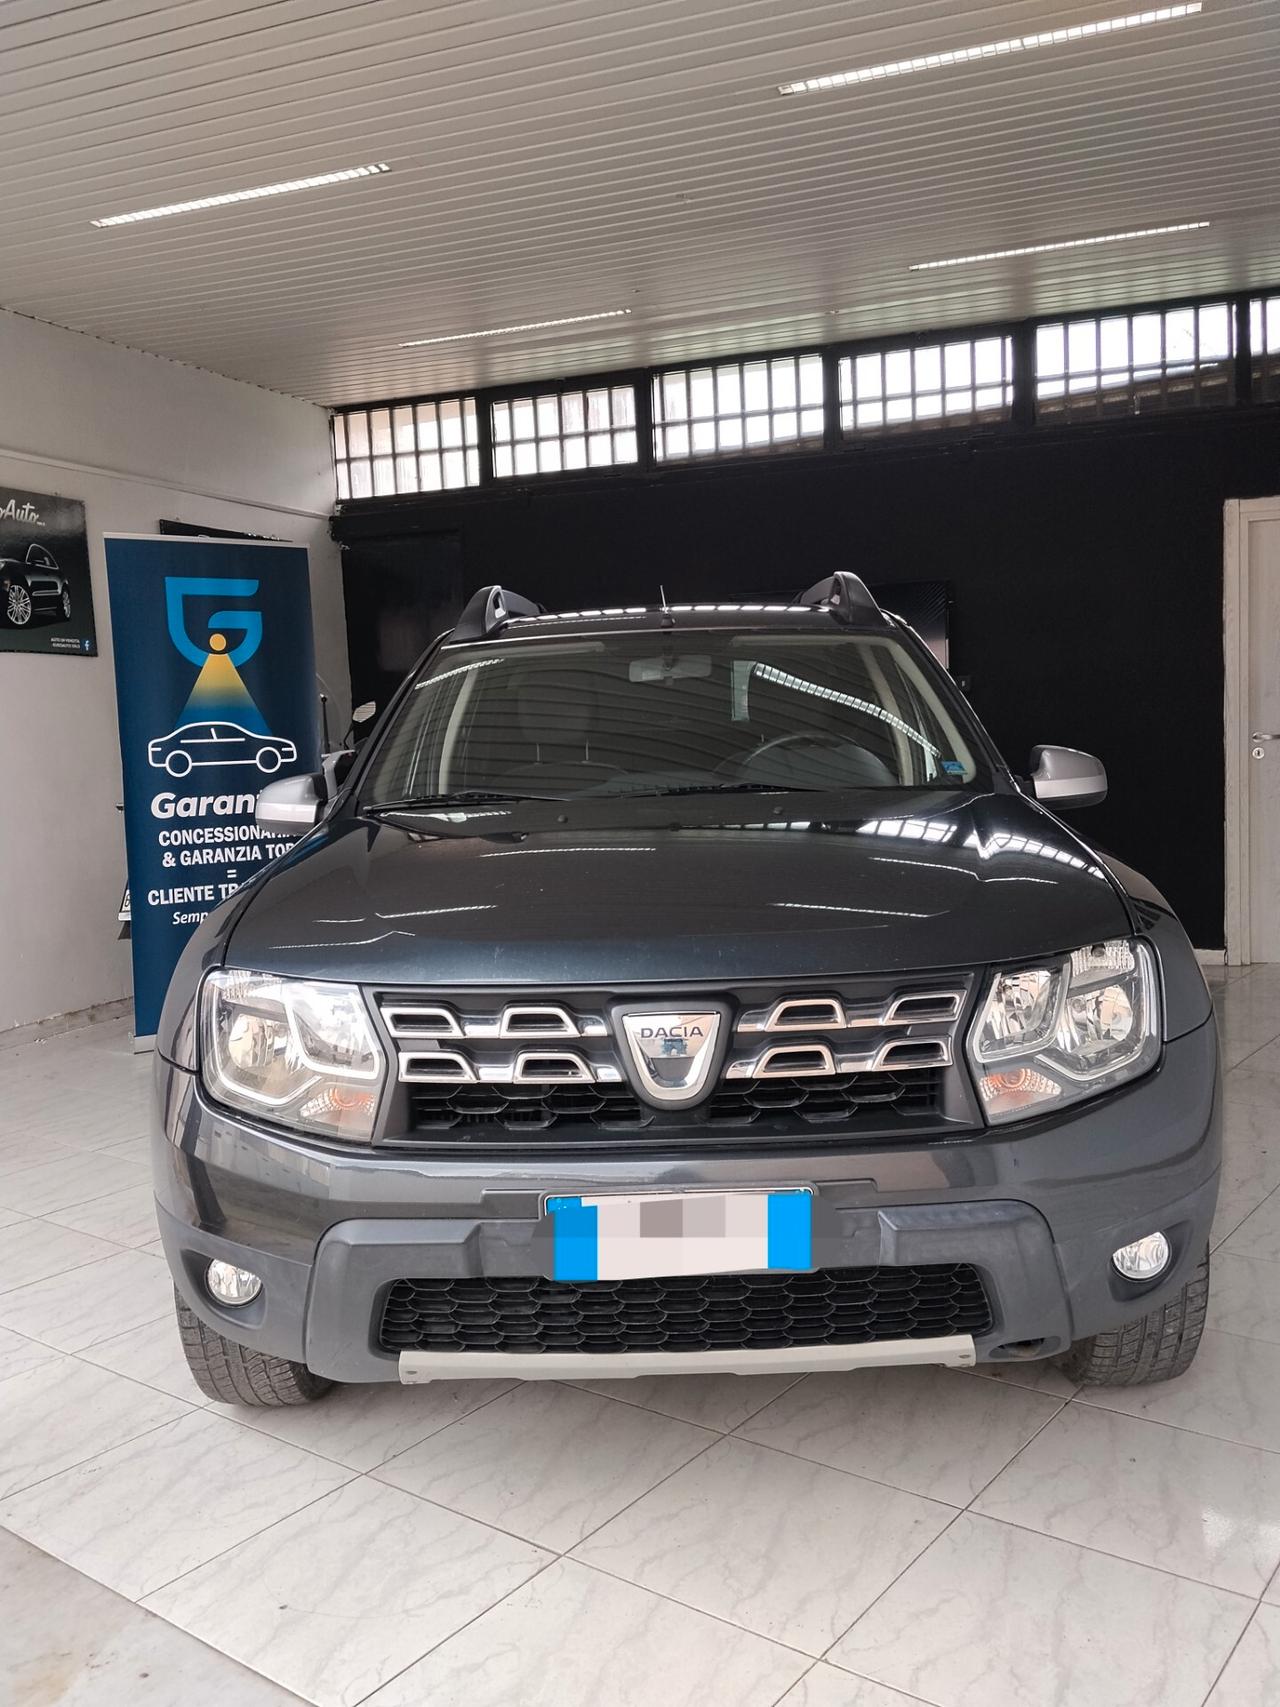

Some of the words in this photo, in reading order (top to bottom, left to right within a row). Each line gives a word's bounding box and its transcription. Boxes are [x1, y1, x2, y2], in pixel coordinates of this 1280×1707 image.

[151, 790, 261, 819] Garan
[162, 852, 176, 867] &
[180, 845, 262, 866] GARANZIA
[147, 885, 215, 905] CLIENTE
[641, 1026, 704, 1038] DACIA
